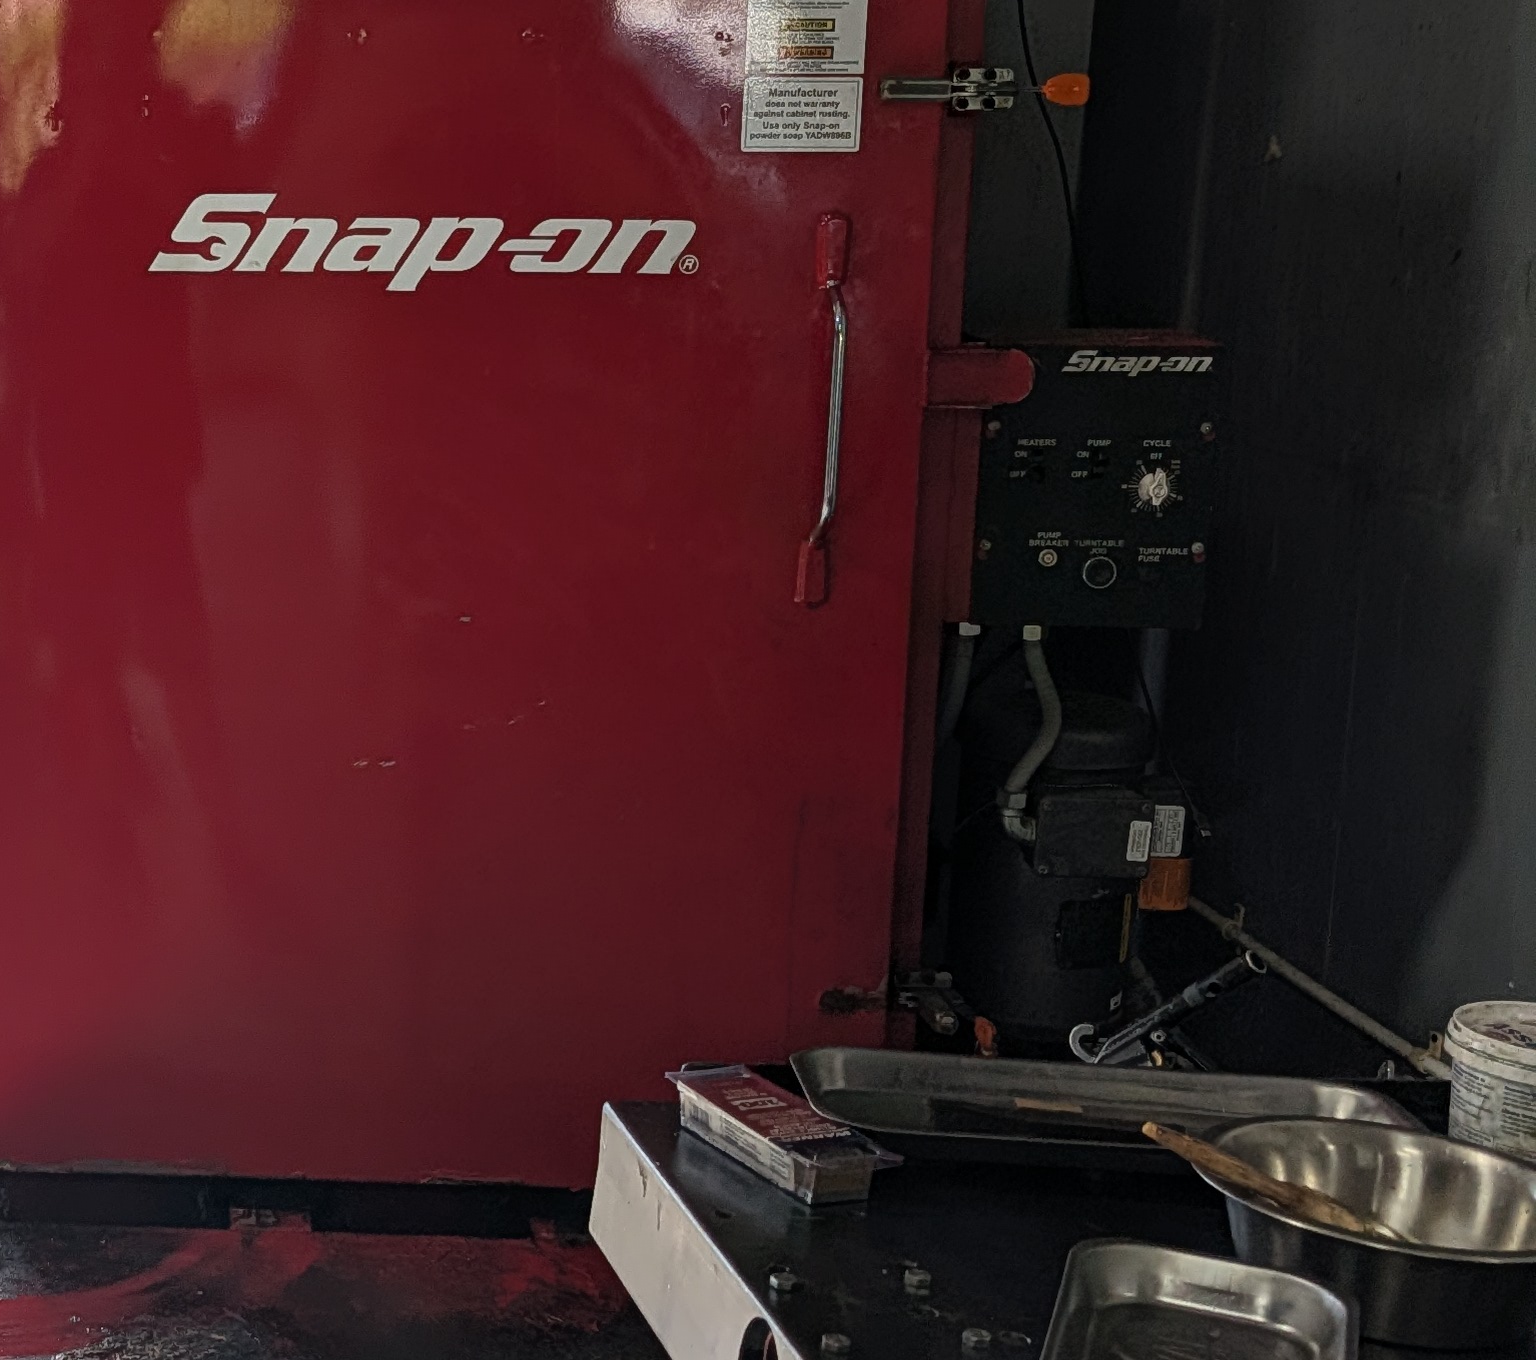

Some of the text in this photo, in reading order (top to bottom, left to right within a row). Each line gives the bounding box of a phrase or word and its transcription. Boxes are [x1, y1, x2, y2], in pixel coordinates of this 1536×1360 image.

[768, 88, 839, 98] Manufacturer
[765, 100, 840, 109] does not warranty
[753, 110, 850, 119] against cabinet rusting.
[762, 121, 840, 131] Use only Snap-on
[750, 131, 781, 140] powder
[783, 133, 803, 141] soap
[148, 192, 697, 292] Snap-on
[1061, 349, 1214, 376] Snap-on
[1017, 438, 1057, 446] HEATERS
[1087, 439, 1112, 447] PUMP
[1143, 439, 1172, 447] CYCLE
[1014, 450, 1028, 458] ON
[1076, 450, 1090, 458] ON
[1071, 470, 1089, 478] OFF
[1037, 531, 1061, 539] PUMP
[1028, 538, 1069, 547] BREAKER
[1074, 539, 1125, 547] TURNTABLE
[1139, 546, 1189, 556] TURNTABLE
[1138, 555, 1160, 563] FUSE
